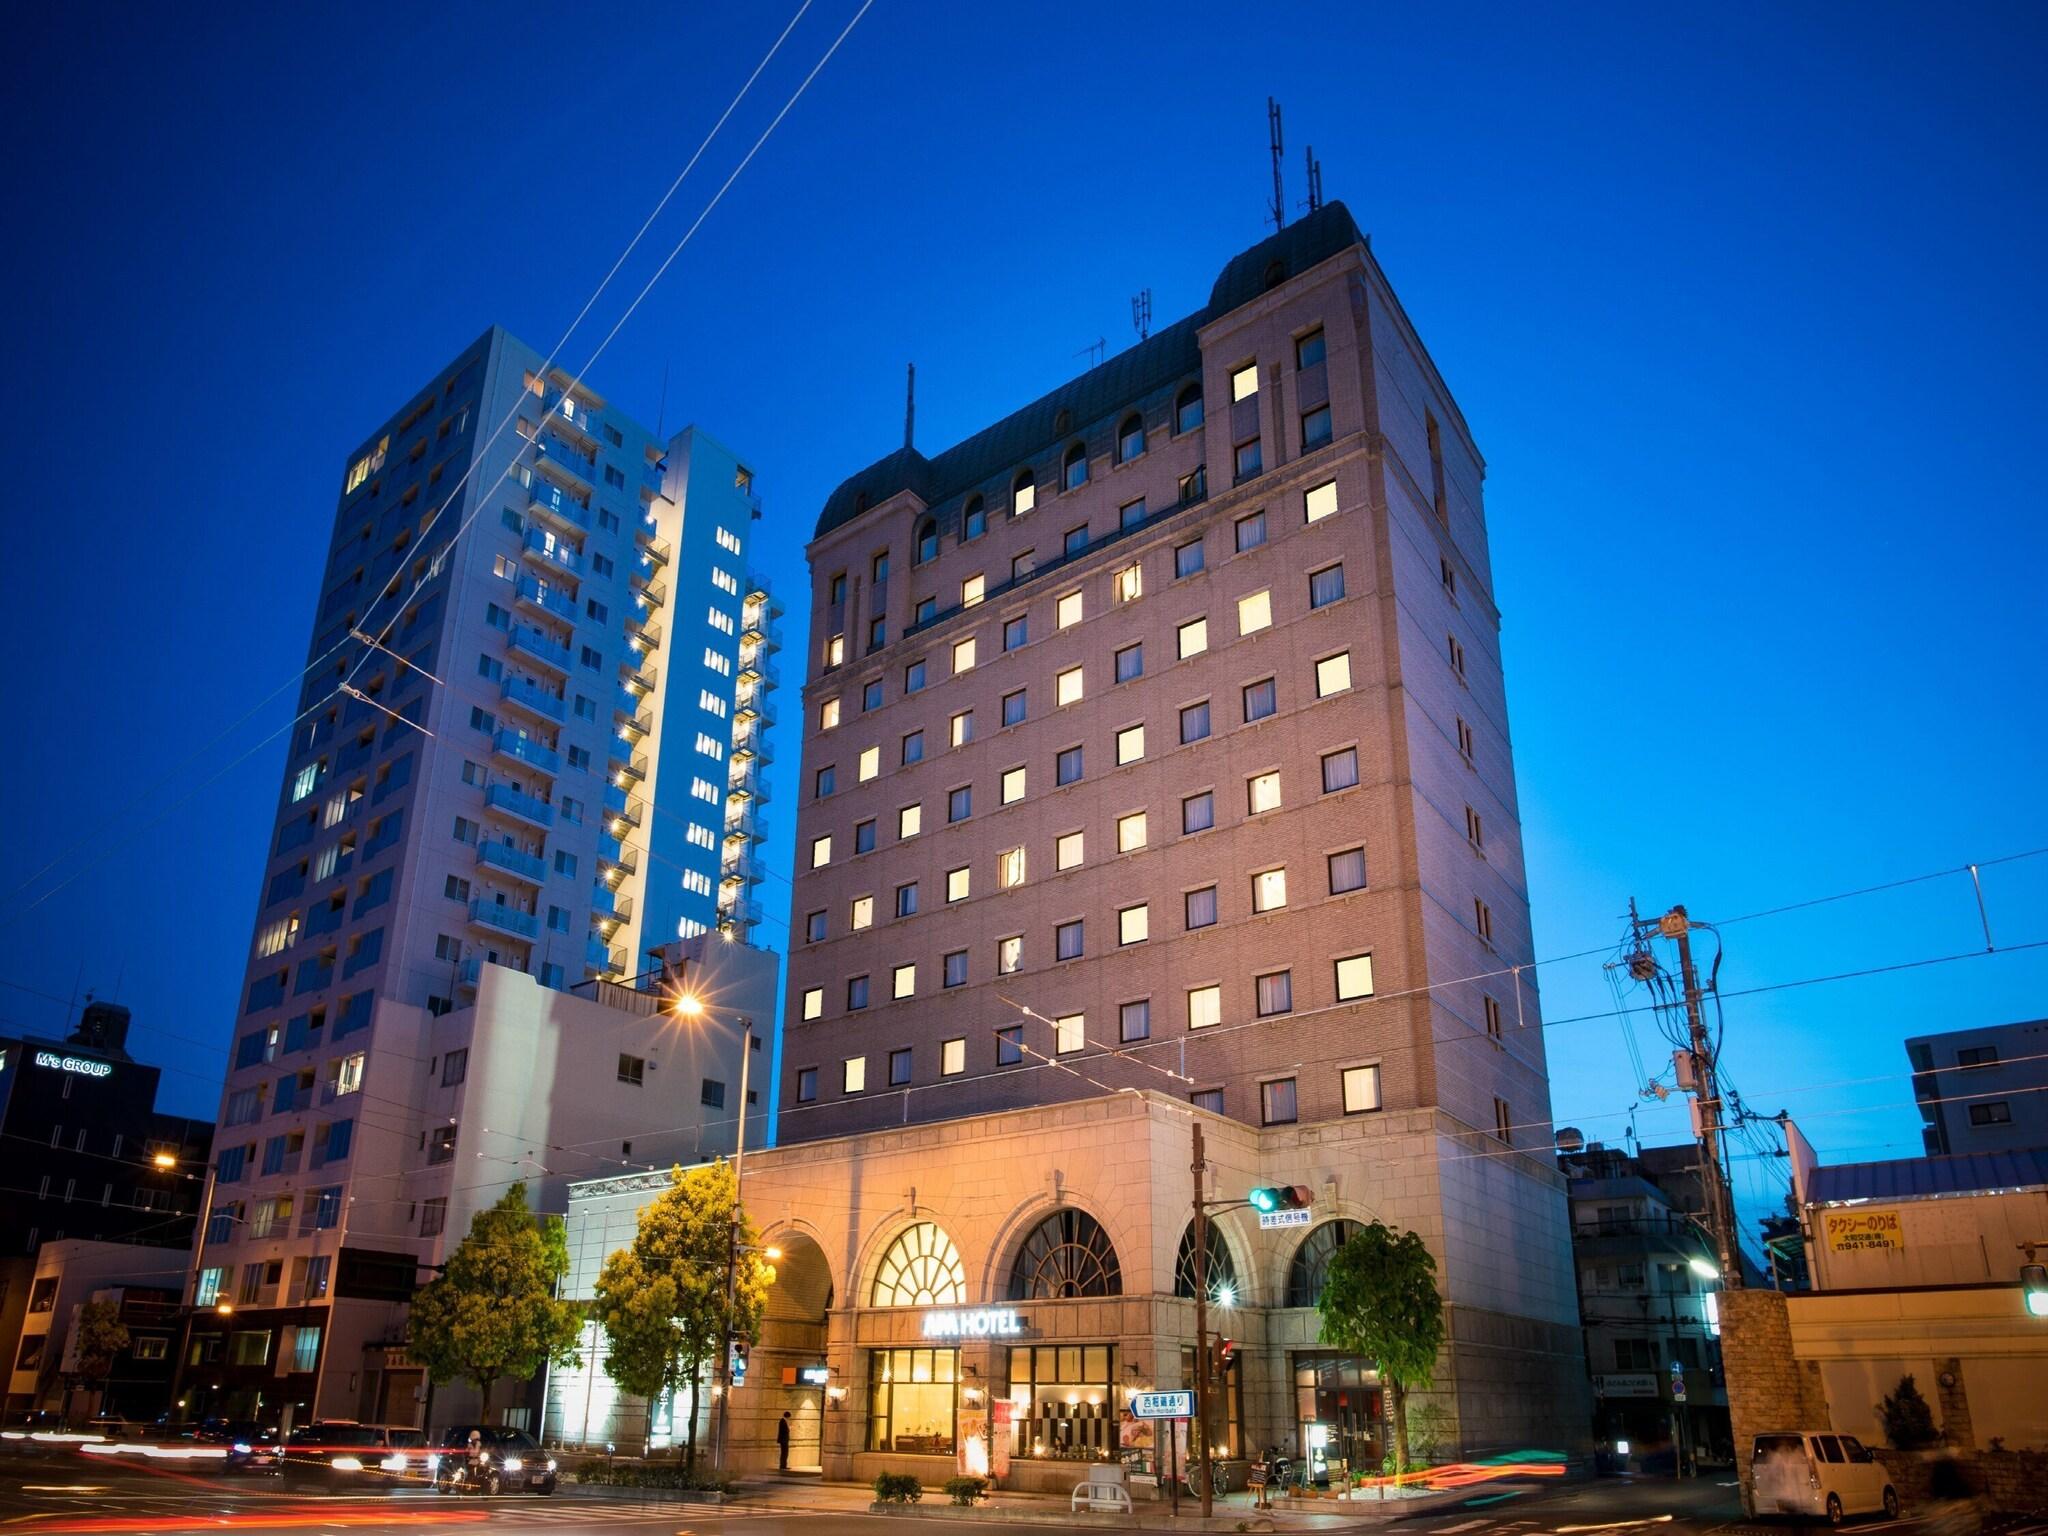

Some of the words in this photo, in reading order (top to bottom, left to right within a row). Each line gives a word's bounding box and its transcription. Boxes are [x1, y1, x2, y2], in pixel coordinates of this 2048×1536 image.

[36, 1052, 61, 1068] M's
[63, 1057, 112, 1077] GROUP
[1262, 1212, 1308, 1226] 時差式信号機
[1829, 1214, 1898, 1233] タクシーのりば
[961, 1310, 1020, 1335] HOTEL
